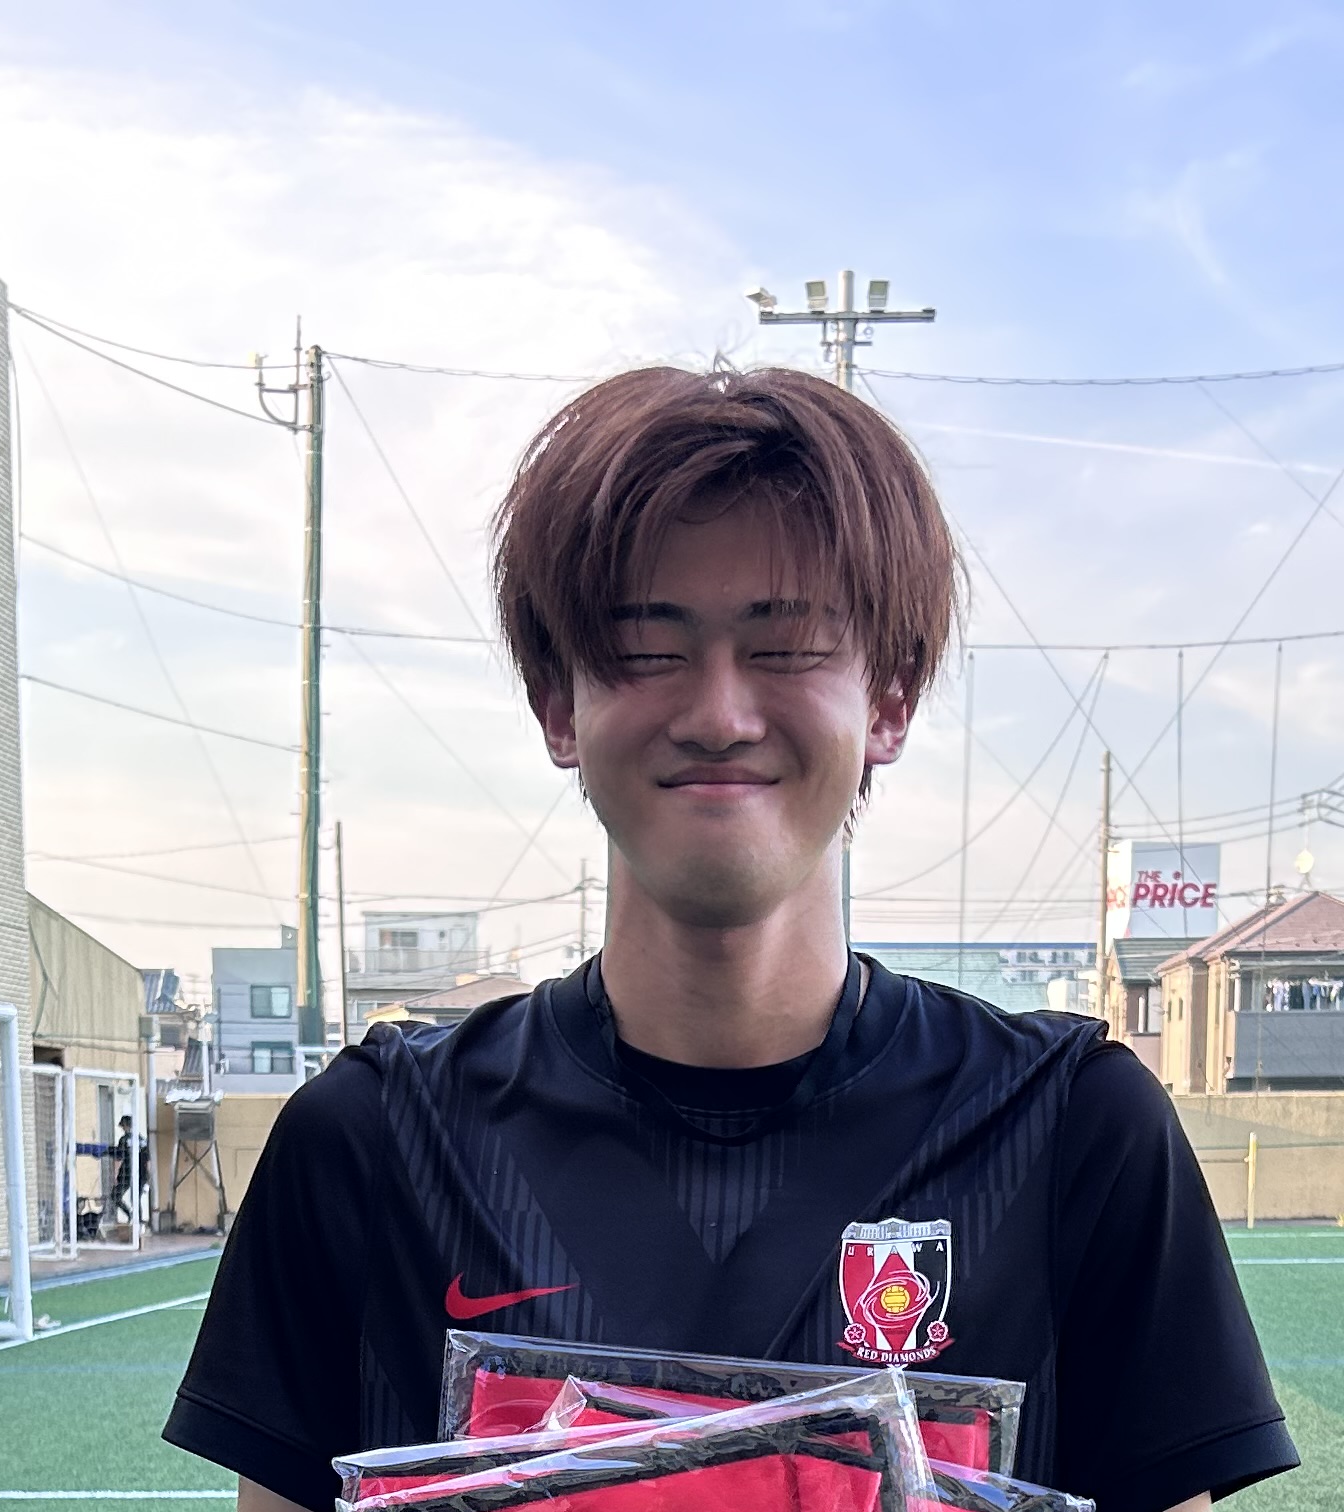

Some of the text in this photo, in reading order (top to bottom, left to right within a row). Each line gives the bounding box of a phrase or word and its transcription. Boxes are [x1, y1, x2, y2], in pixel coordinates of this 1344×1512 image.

[1137, 870, 1162, 882] THE
[847, 1241, 944, 1256] URAWA
[856, 1347, 937, 1362] RED DIAMONDS
